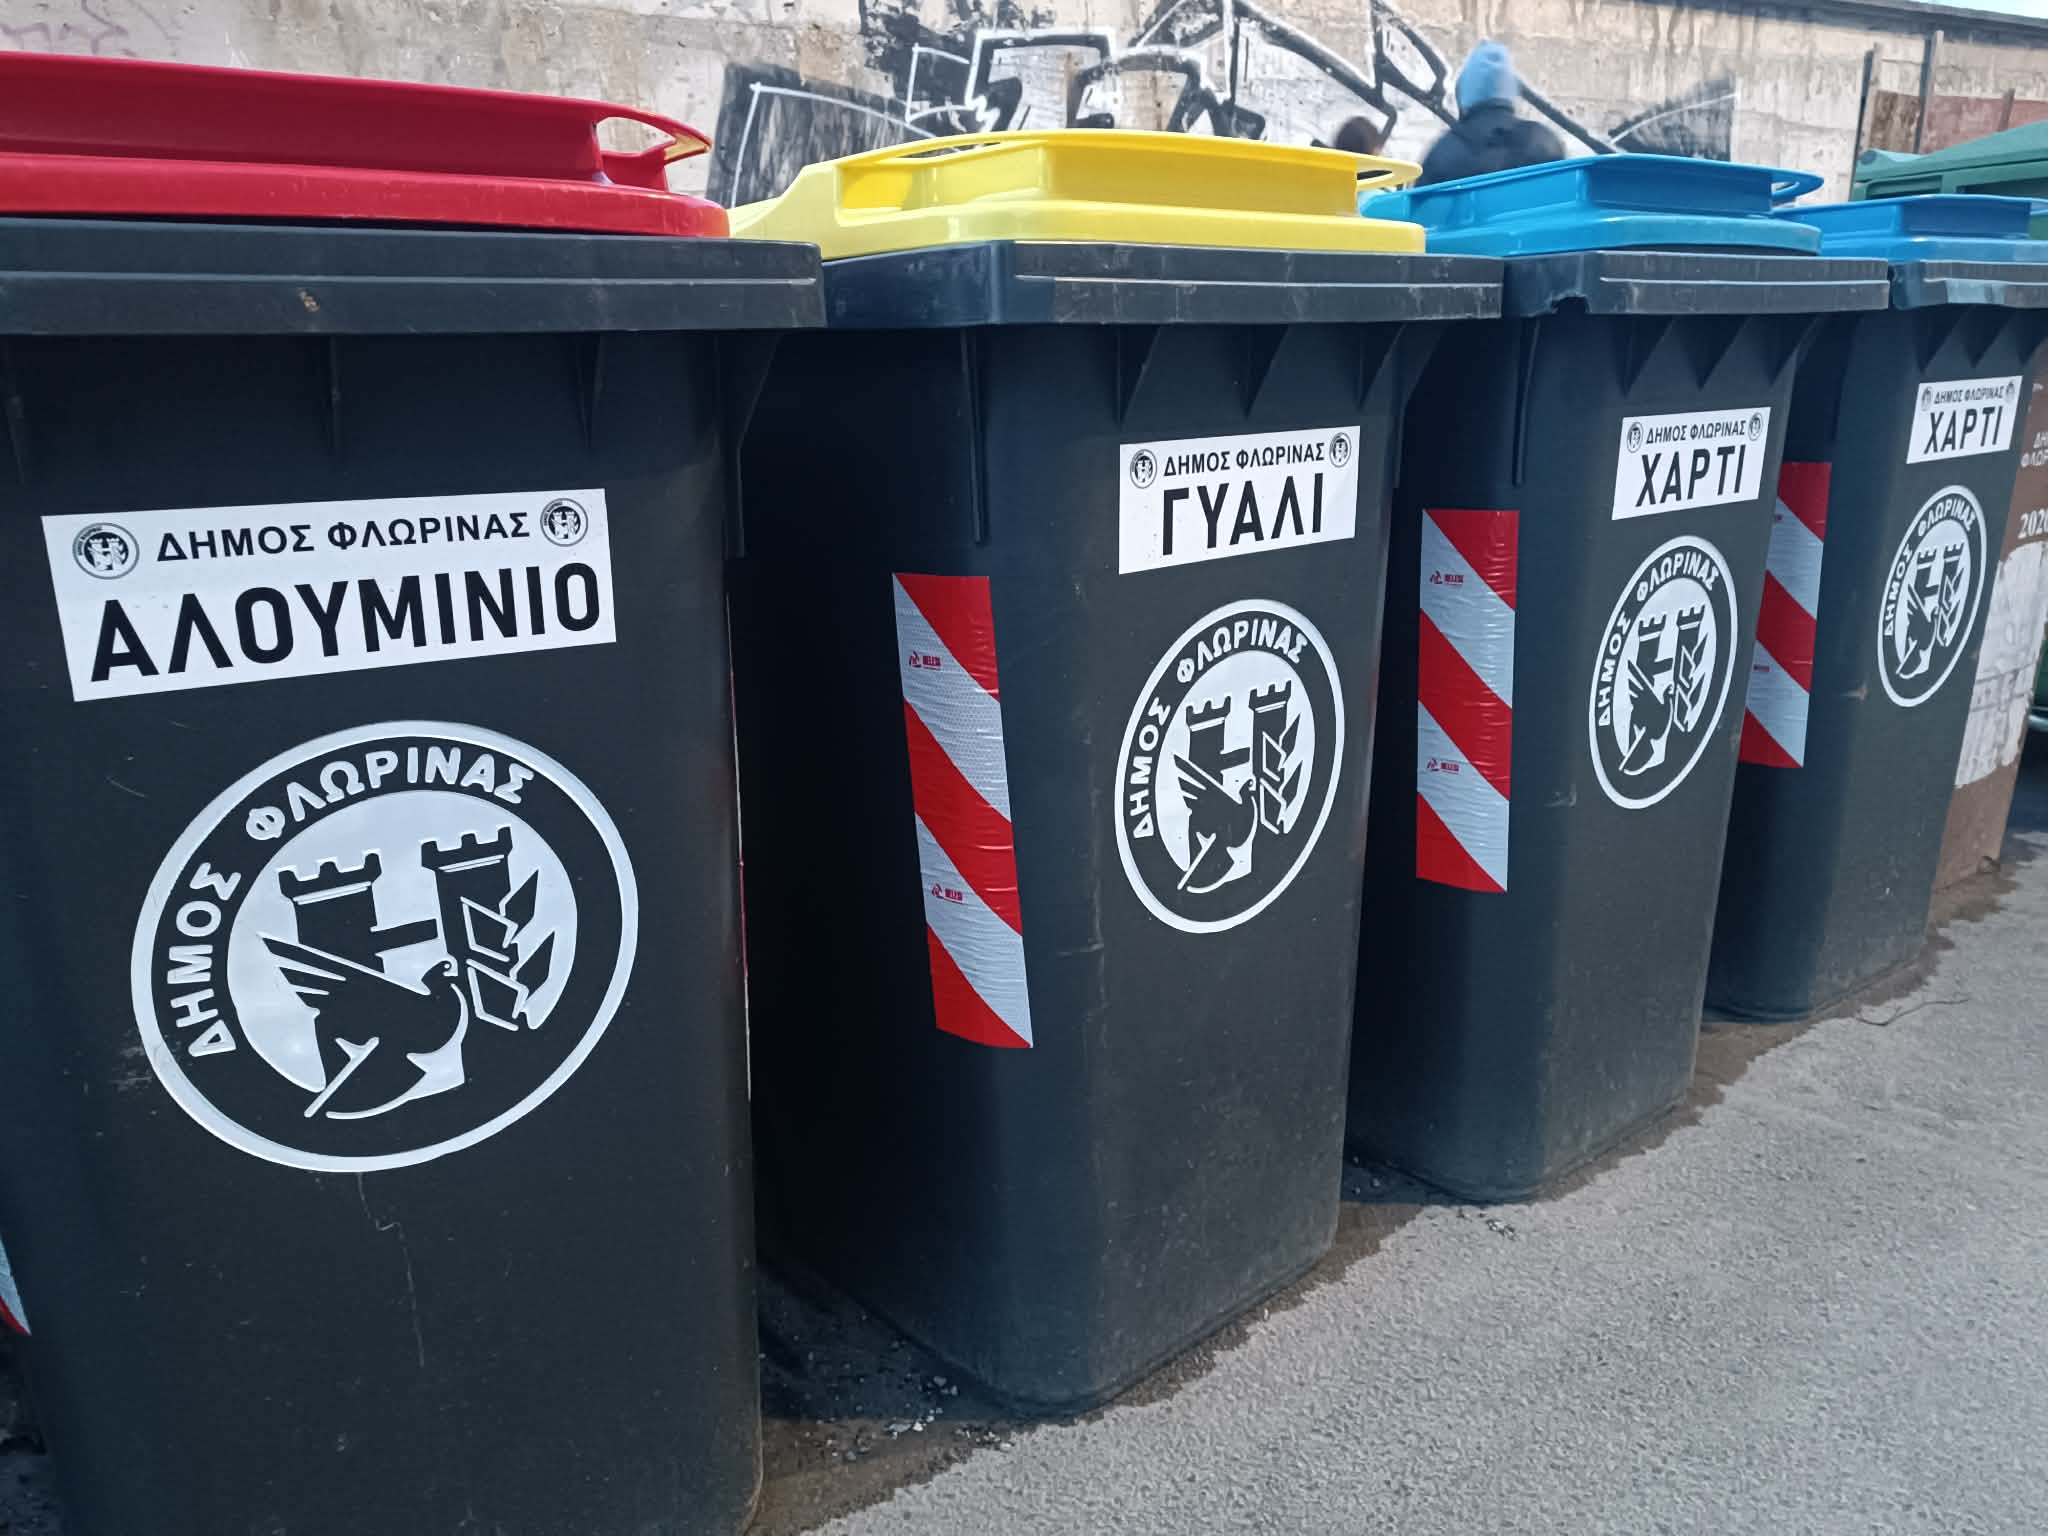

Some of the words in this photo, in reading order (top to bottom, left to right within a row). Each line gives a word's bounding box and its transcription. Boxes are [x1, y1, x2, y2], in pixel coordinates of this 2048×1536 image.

[1164, 451, 1231, 477] ΔΗΜΟΣ
[1236, 442, 1325, 470] ΦΛΩΡΙΝΑΣ
[1646, 425, 1687, 444] ΔΗΜΟΣ
[1690, 420, 1746, 440] ΦΛΩΡΙΝΑΣ
[1923, 405, 2003, 455] ΧΑΡΤΙ
[1162, 472, 1324, 556] ΓΥΑΛΙ
[1635, 444, 1746, 508] ΧΑΡΤΙ
[157, 525, 314, 562] ΔΗΜΟΣ
[327, 511, 530, 551] ΦΛΩΡΙΝΑΣ
[1884, 543, 1913, 636] ΔΗΜΟΣ
[1918, 499, 1976, 537] ΦΛΩΡΙΝΑΣ
[90, 562, 600, 683] ΑΛΟΥΜΙΝΙΟ
[1598, 611, 1631, 727] ΔΗΜΟΣ
[1636, 551, 1719, 602] ΦΛΩΡΙΝΑΣ
[1129, 697, 1171, 839] ΔΗΜΟΣ
[1176, 618, 1308, 683] ΦΛΩΡΙΝΑΣ
[167, 862, 242, 1058] ΔΗΜΟΣ
[246, 746, 535, 841] ΦΛΩΡΙΝΑΣ
